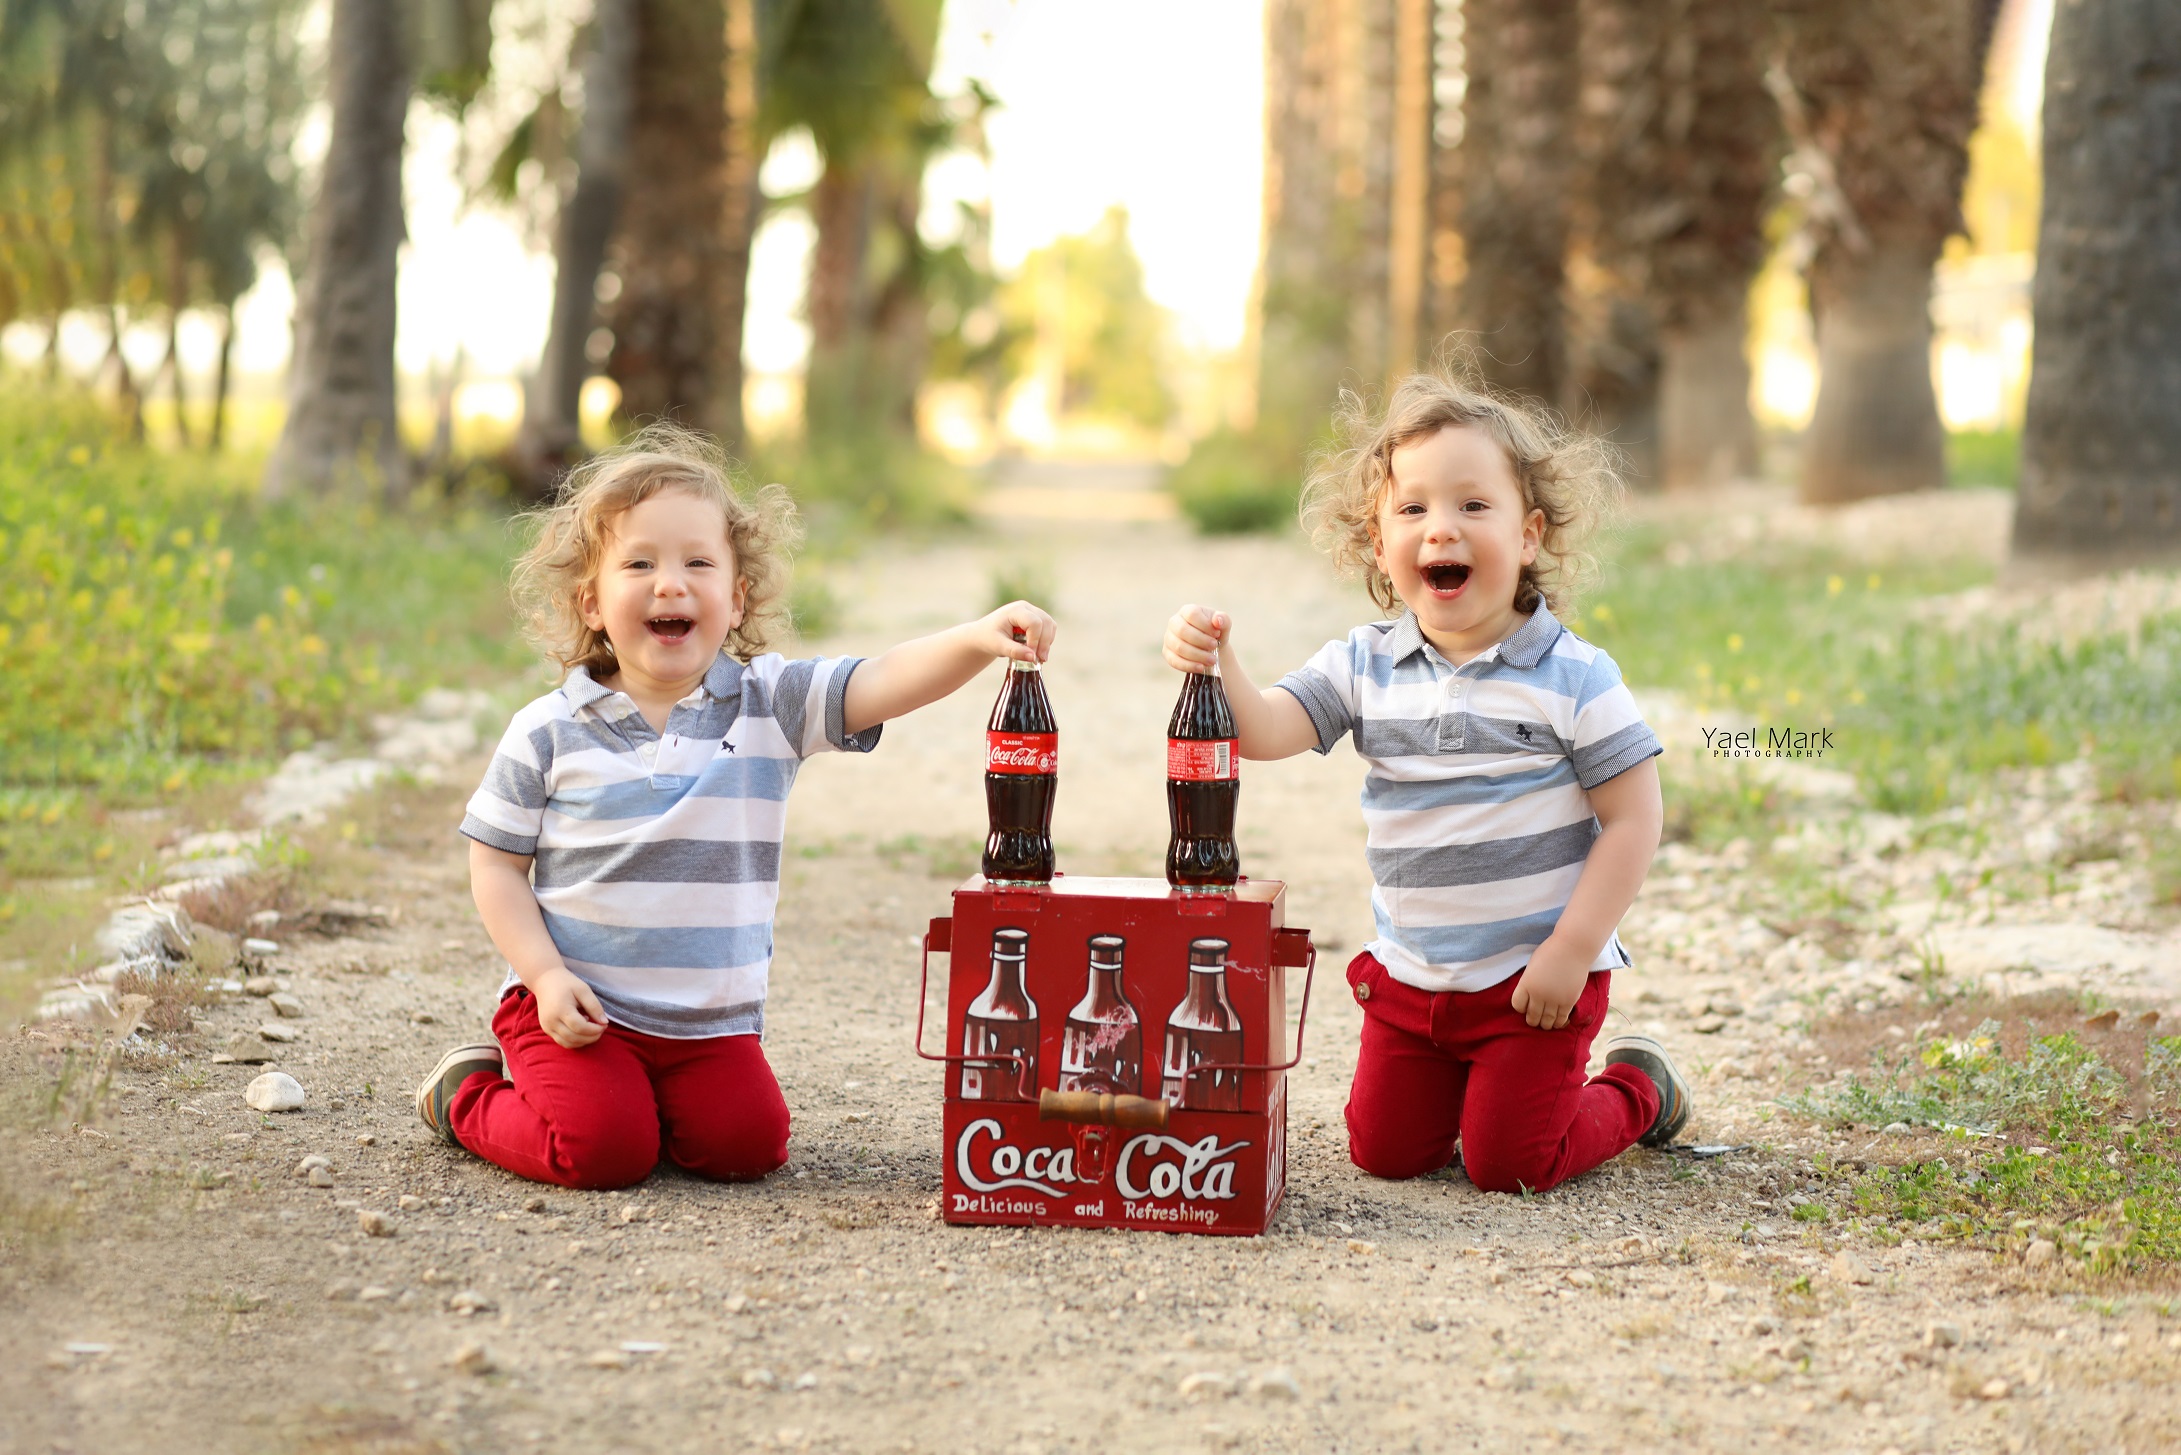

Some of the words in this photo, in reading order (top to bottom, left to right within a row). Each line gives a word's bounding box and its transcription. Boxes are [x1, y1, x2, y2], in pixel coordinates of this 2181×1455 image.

[990, 745, 1040, 766] Coca-Cola
[957, 1117, 1078, 1198] Coca
[1115, 1133, 1251, 1200] Cola
[952, 1194, 1047, 1216] Delicious
[1074, 1200, 1104, 1217] and
[1123, 1201, 1219, 1225] Refreshing
